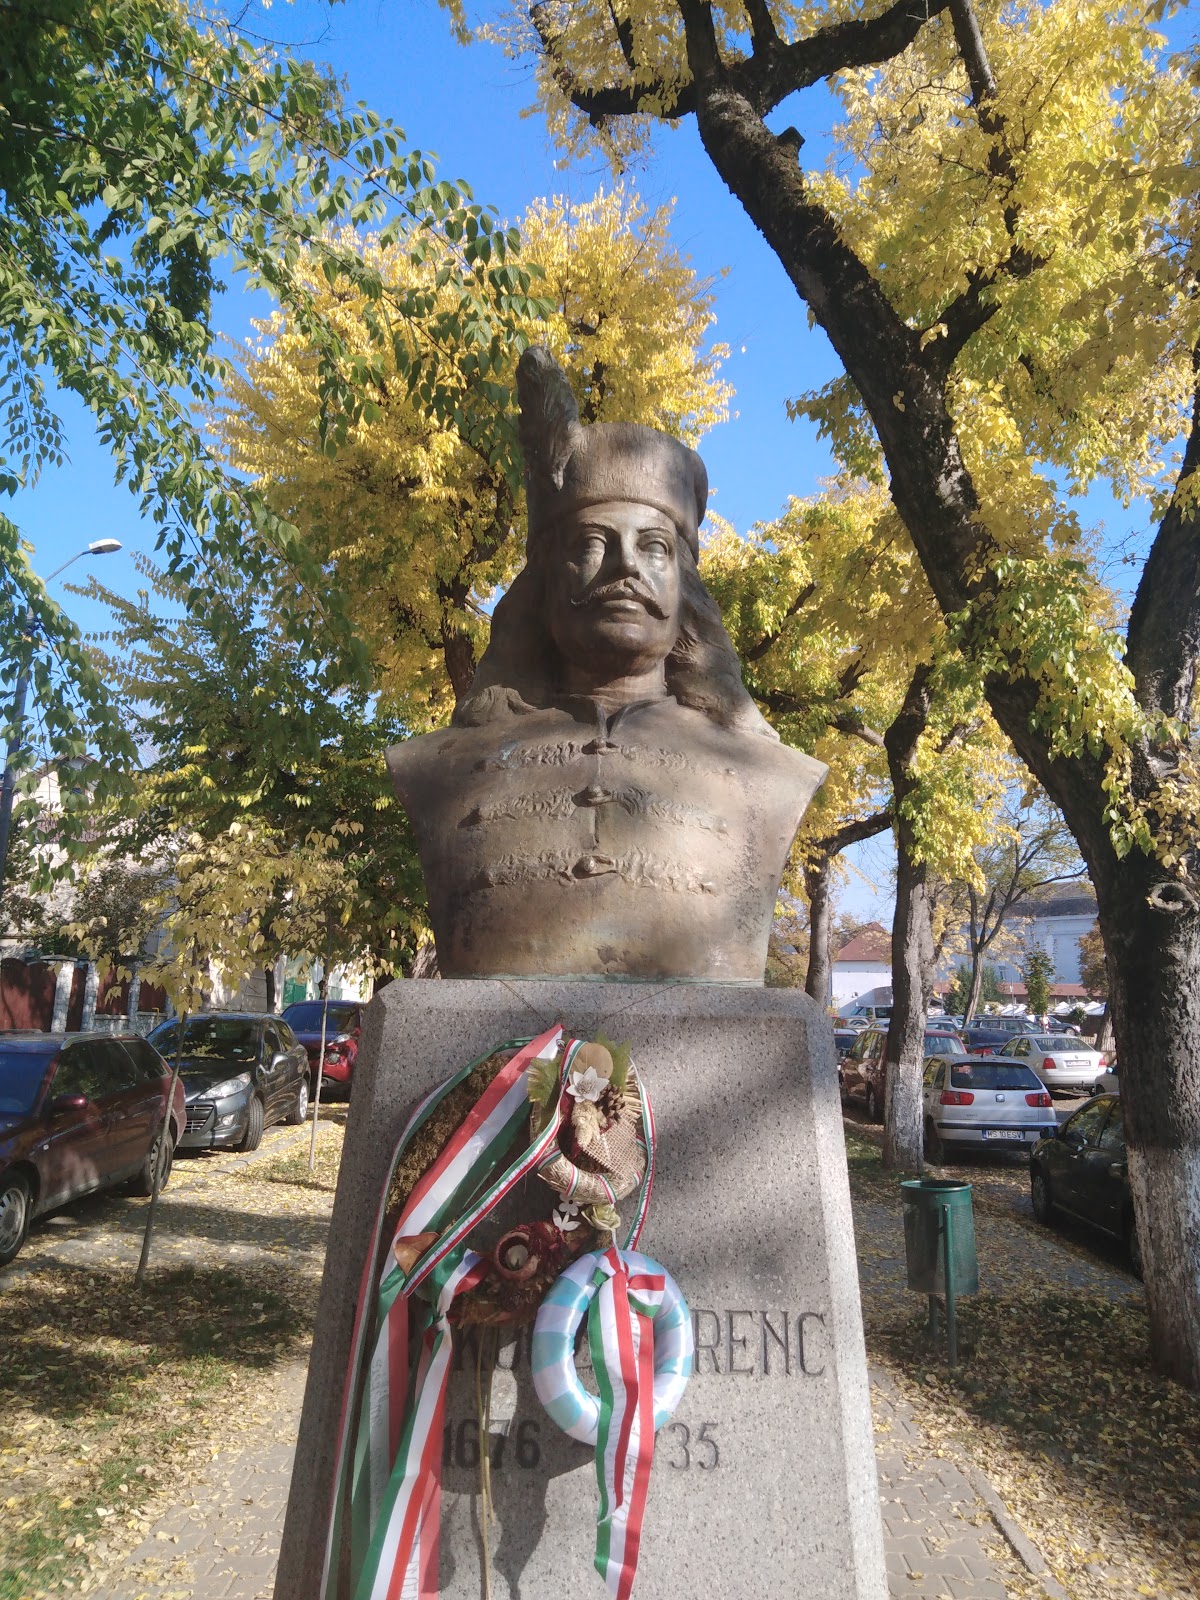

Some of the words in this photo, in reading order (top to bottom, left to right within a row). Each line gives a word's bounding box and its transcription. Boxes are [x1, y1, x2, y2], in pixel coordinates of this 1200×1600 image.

[690, 1308, 826, 1377] RENC
[442, 1418, 541, 1470] 1676
[669, 1421, 720, 1471] 35
